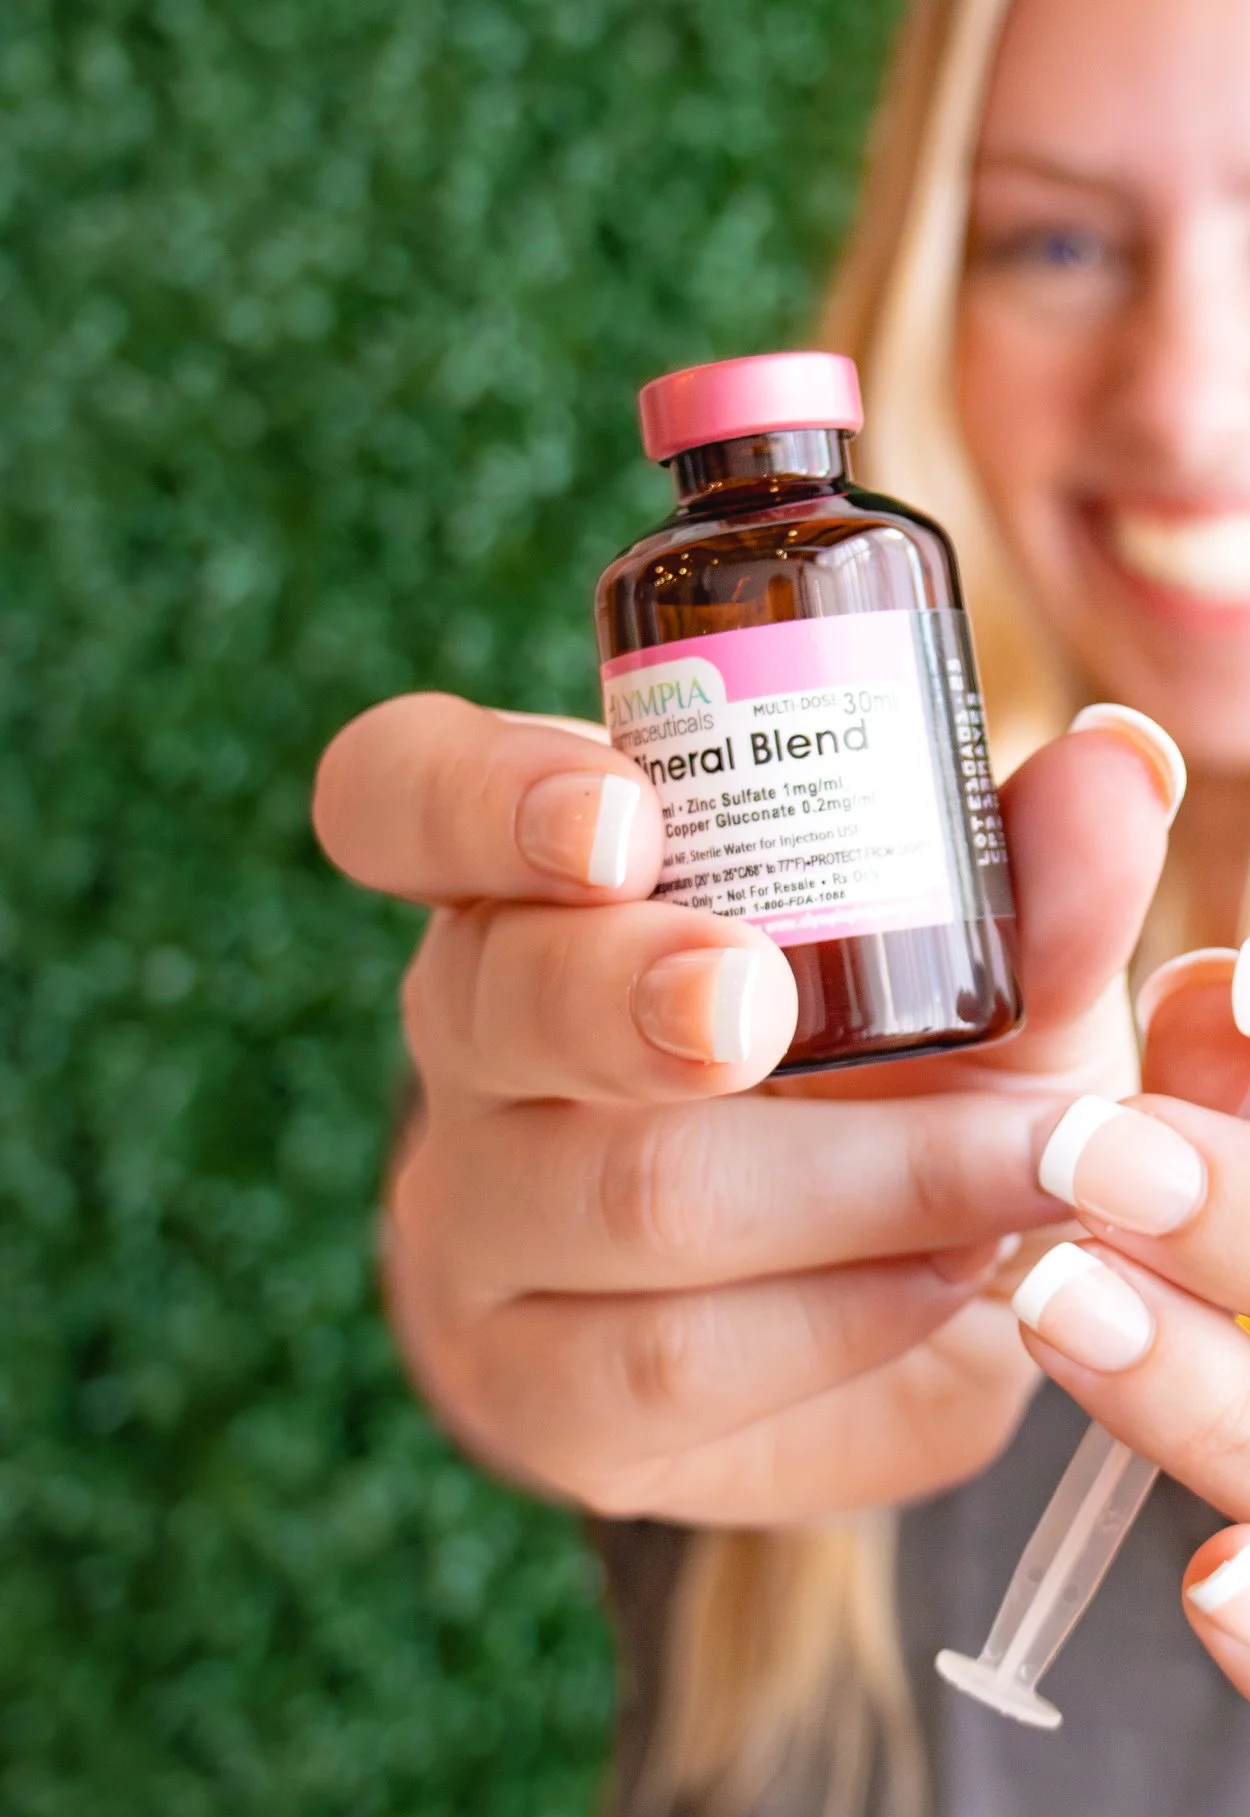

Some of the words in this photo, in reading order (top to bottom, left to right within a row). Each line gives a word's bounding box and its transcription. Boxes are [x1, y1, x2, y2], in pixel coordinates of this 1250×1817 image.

[843, 690, 897, 716] 30ml
[634, 737, 735, 786] ineral
[750, 718, 869, 766] Blend
[687, 797, 716, 814] Zinc
[721, 787, 776, 808] Sulfate
[783, 776, 843, 798] 1mg/ml
[665, 819, 710, 839] Copper
[715, 804, 796, 828] Gluconate
[802, 791, 876, 815] 0.2mg/ml
[690, 846, 722, 862] Sterile
[723, 837, 757, 855] Water
[760, 836, 777, 850] for
[779, 828, 834, 848] Injection
[766, 863, 776, 875] to
[692, 894, 713, 909] Only
[727, 888, 746, 902] Not
[750, 885, 769, 898] For
[773, 876, 815, 894] Resale
